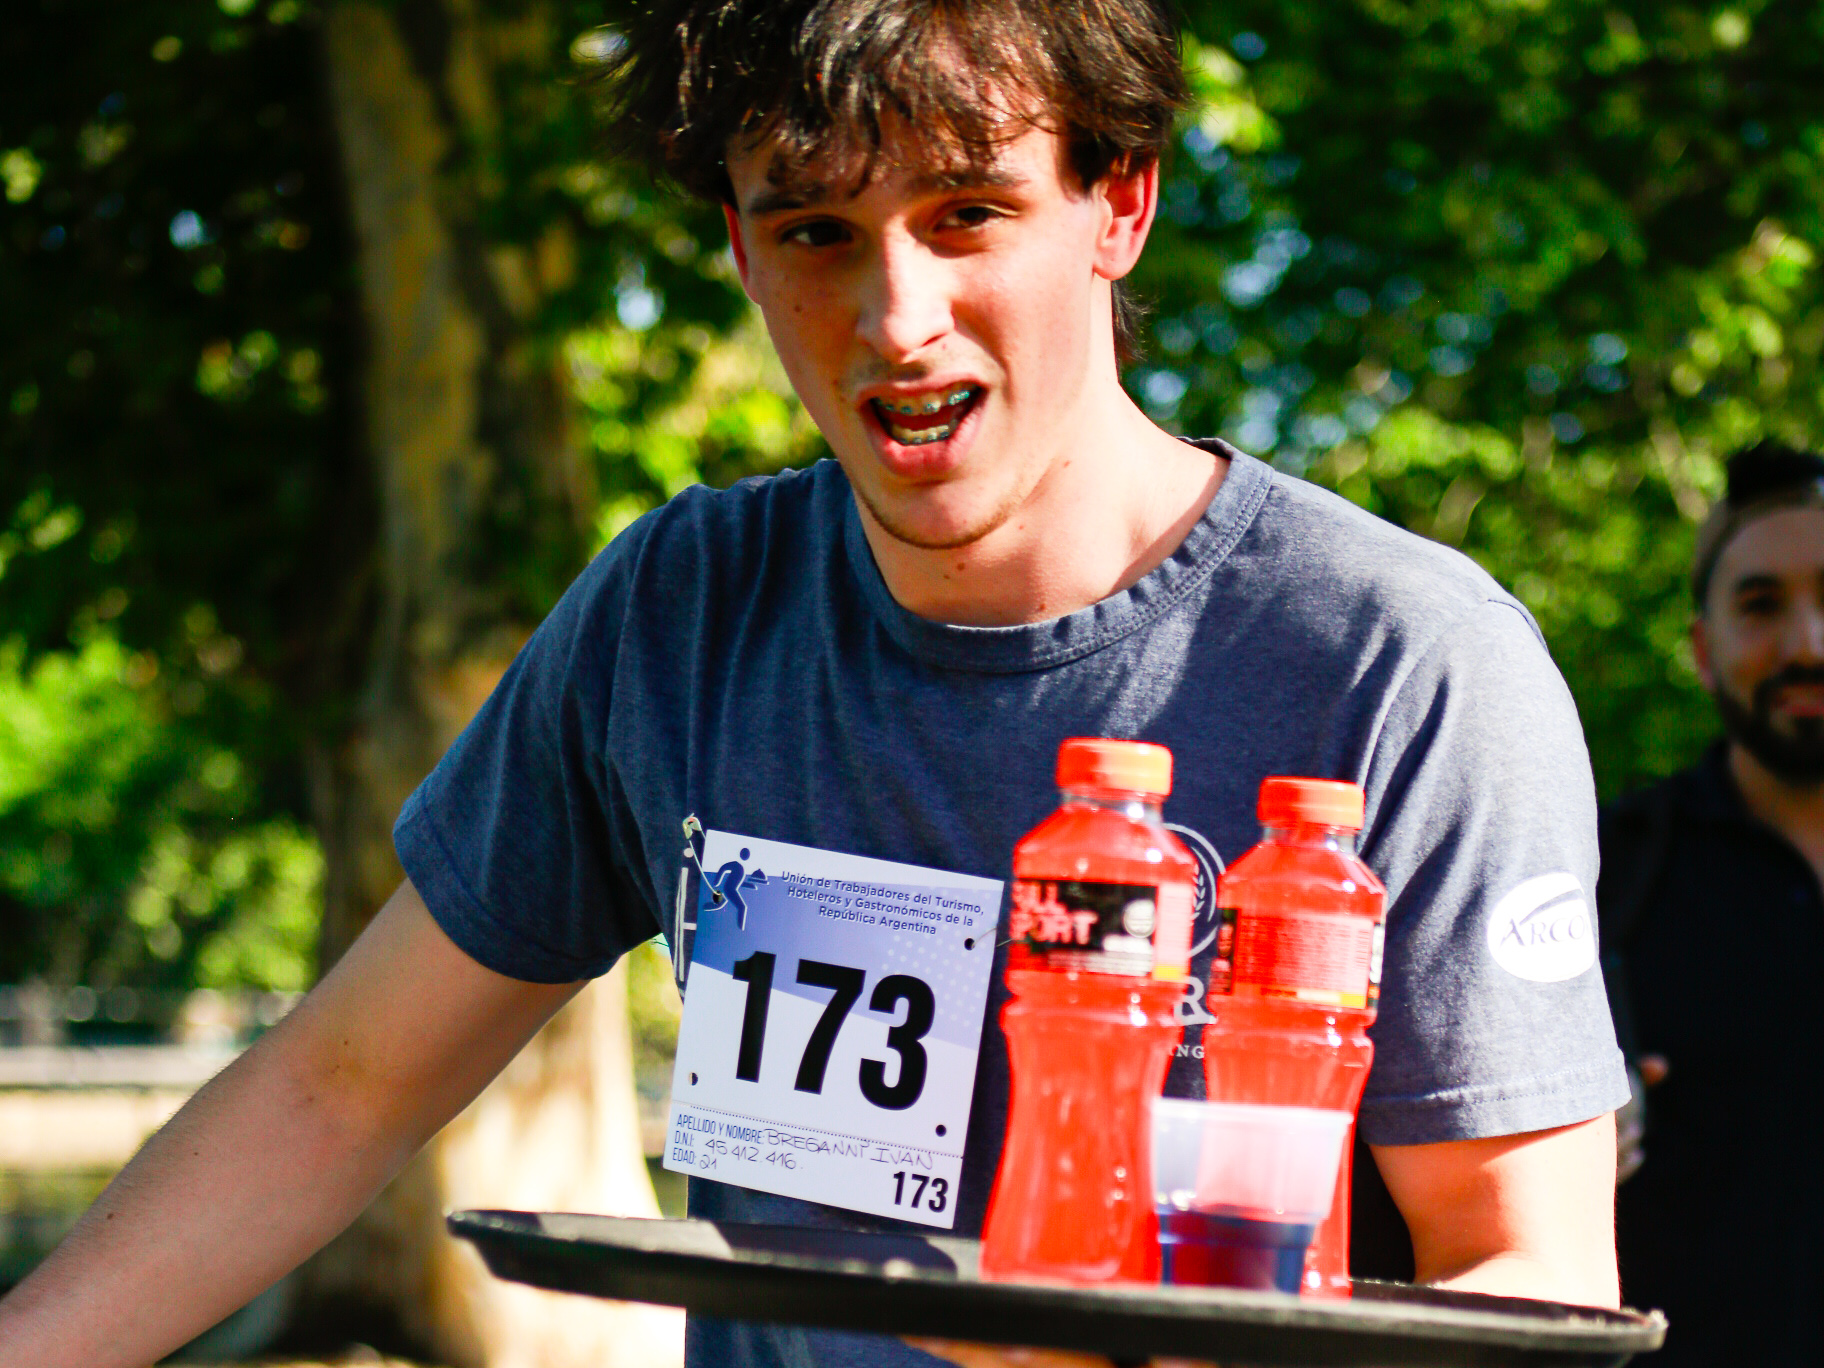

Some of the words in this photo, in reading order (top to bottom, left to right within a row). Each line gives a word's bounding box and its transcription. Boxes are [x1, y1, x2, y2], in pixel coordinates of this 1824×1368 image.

[782, 871, 813, 886] Unión
[817, 878, 831, 889] de
[835, 880, 909, 902] Trabajadores
[913, 894, 932, 905] del
[935, 897, 985, 916] Turismo,
[788, 886, 842, 904] Hoteleros
[845, 897, 852, 907] y
[855, 898, 942, 921] Gastronómicos
[946, 914, 959, 924] de
[963, 916, 973, 927] la
[819, 906, 875, 924] República
[879, 916, 936, 935] Argentina
[732, 950, 936, 1111] 173
[677, 1114, 716, 1134] APELLIDO
[719, 1122, 725, 1135] Y
[726, 1124, 764, 1144] NOMBRE:
[673, 1147, 696, 1165] EDAD:
[870, 1147, 933, 1170] IVAN
[893, 1171, 949, 1213] 173
